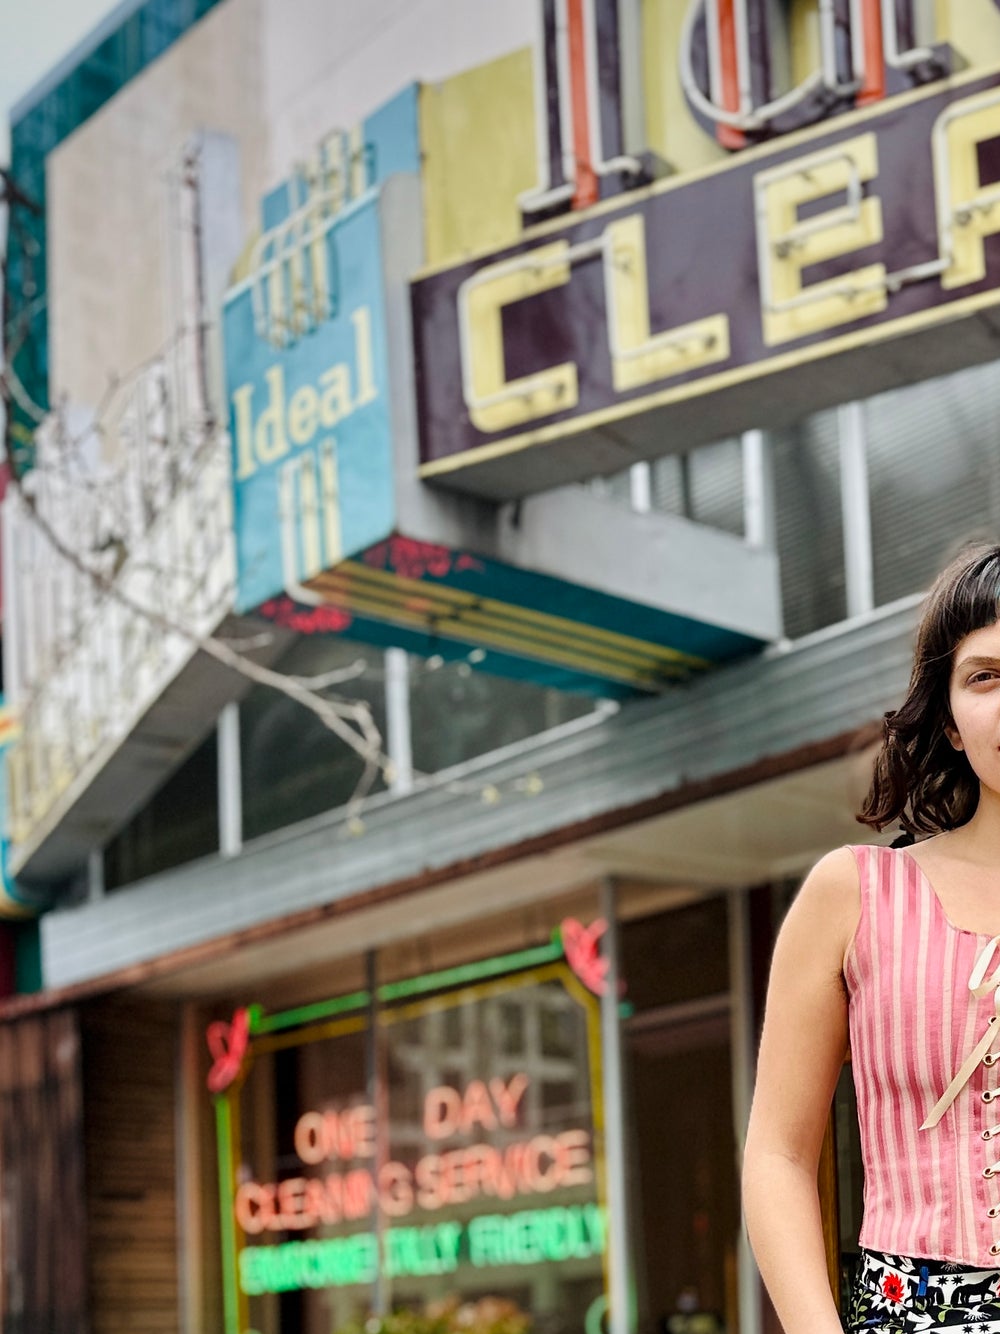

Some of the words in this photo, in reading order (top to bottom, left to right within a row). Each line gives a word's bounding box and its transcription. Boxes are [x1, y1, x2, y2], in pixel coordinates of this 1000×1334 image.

[233, 305, 378, 481] Ideal
[294, 1104, 378, 1165] ONE
[424, 1073, 529, 1140] DAY
[236, 1161, 414, 1234] CLEANIG
[415, 1130, 593, 1210] SERVICE
